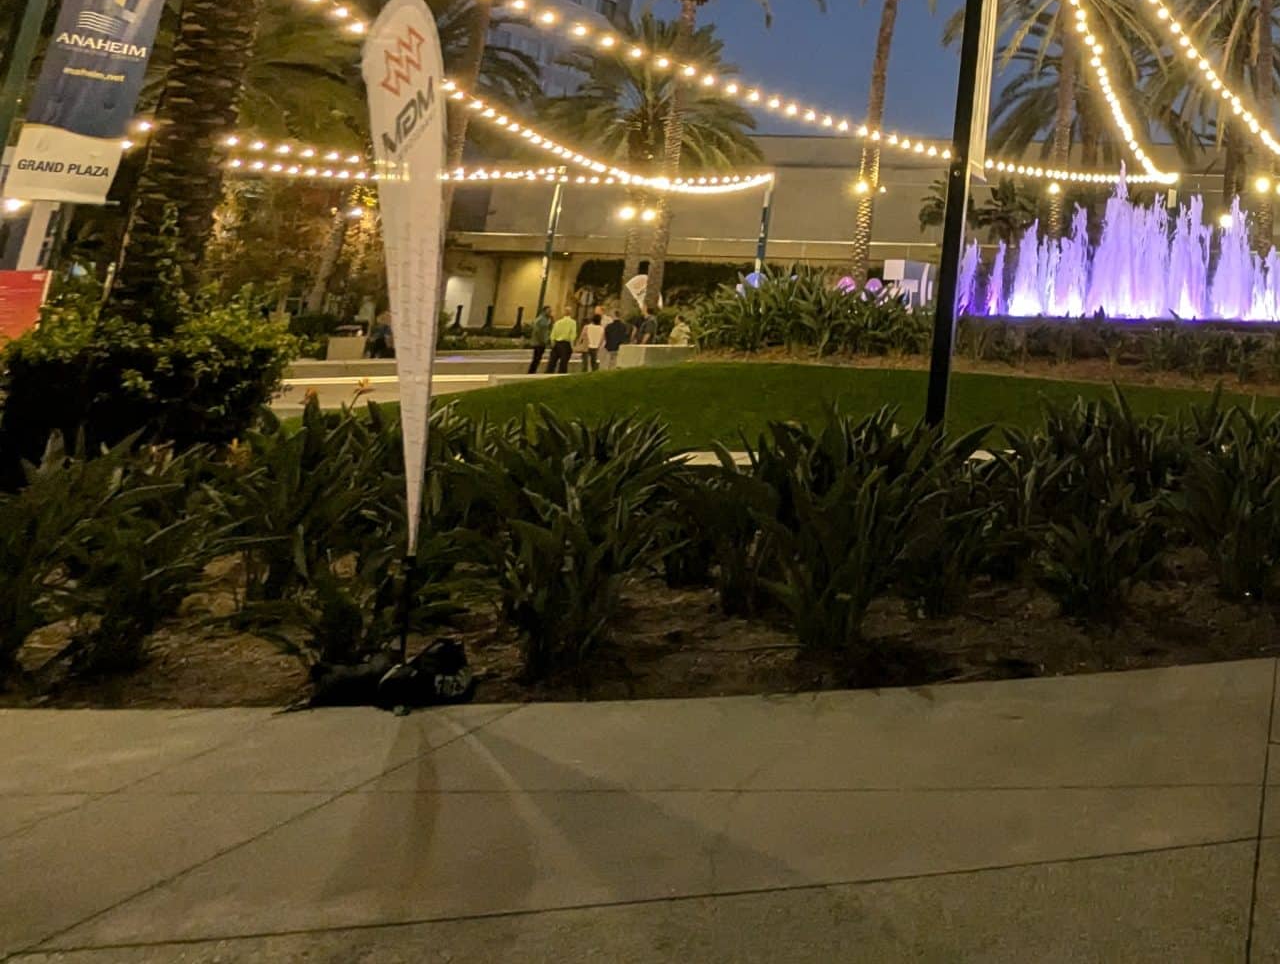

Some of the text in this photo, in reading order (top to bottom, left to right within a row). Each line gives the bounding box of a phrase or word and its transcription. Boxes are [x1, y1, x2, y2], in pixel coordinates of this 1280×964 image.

[56, 32, 147, 58] ANAHEIM
[17, 159, 109, 177] GRAND PLAZA
